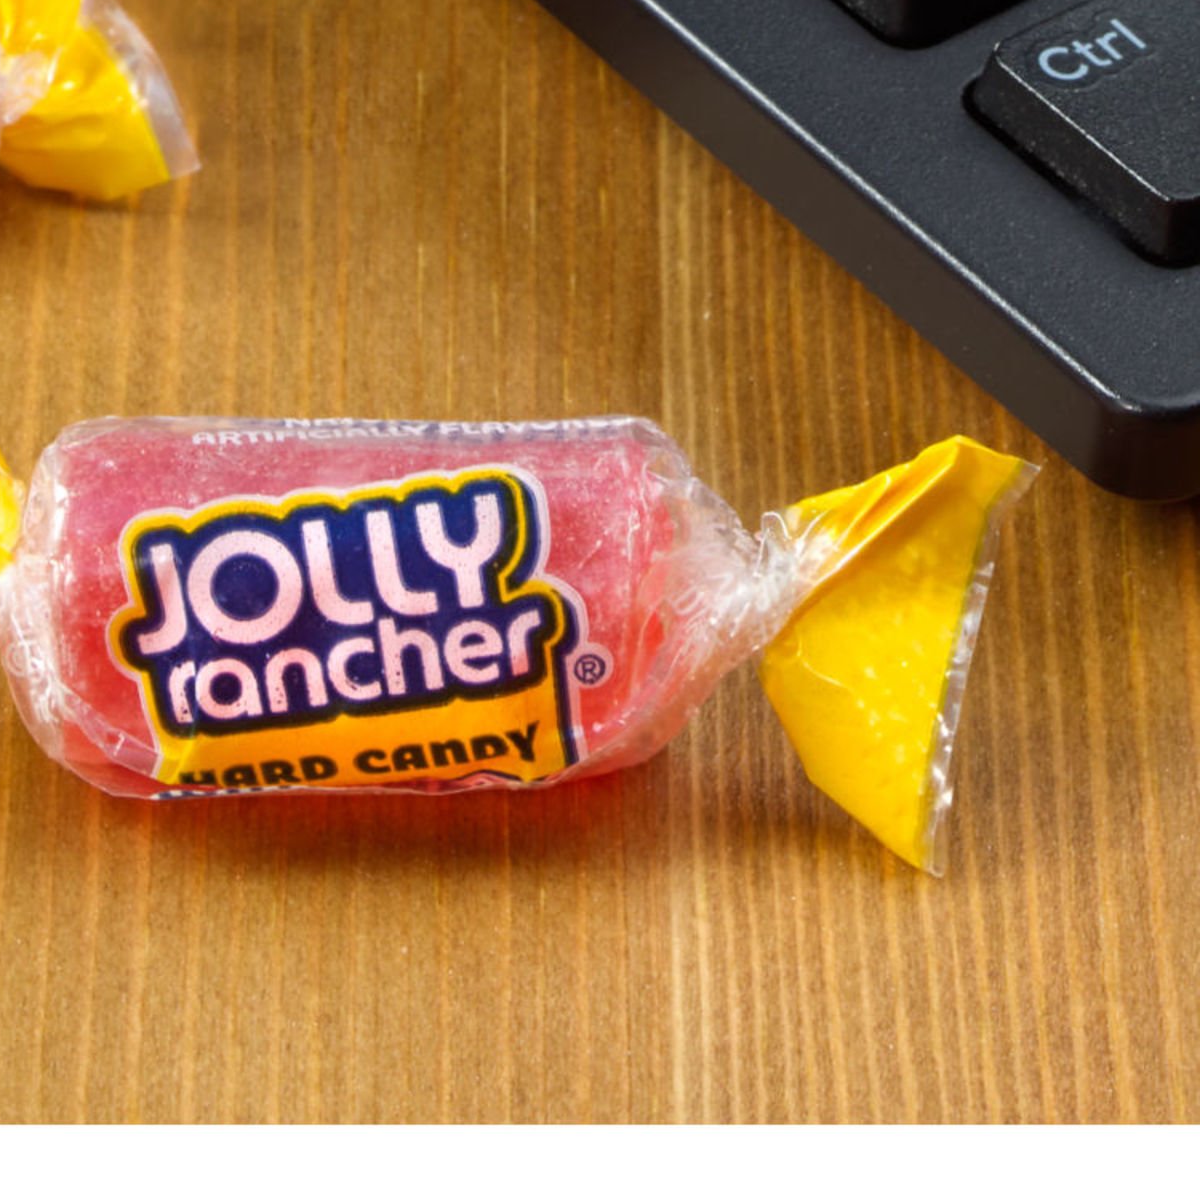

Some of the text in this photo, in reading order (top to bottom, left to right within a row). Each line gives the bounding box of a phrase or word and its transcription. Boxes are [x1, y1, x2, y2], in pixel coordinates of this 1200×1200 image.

[1037, 17, 1148, 81] Ctrl
[137, 493, 502, 655] JOLLY
[166, 608, 542, 724] rancher
[353, 722, 540, 775] CANDY
